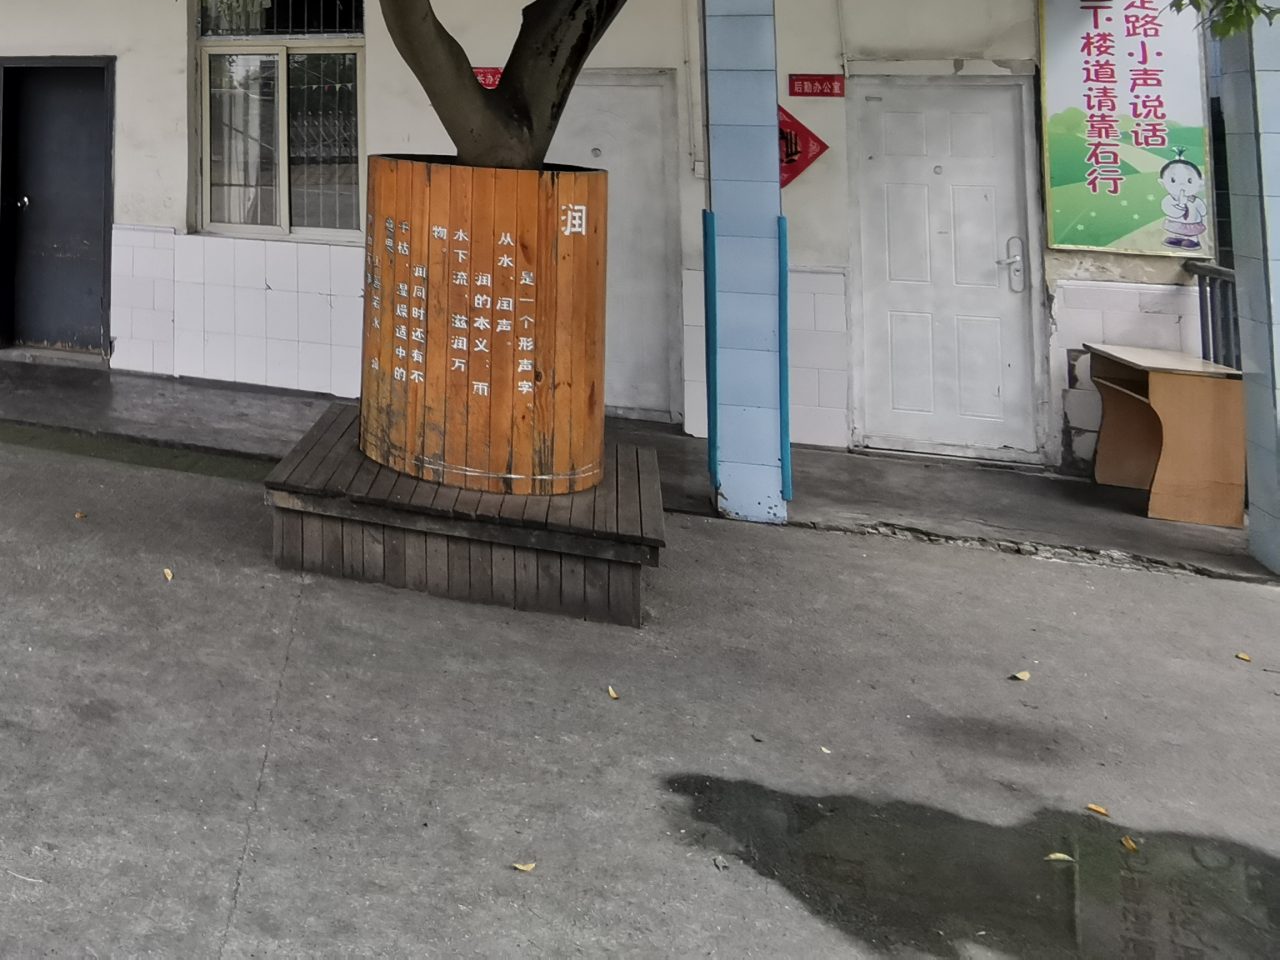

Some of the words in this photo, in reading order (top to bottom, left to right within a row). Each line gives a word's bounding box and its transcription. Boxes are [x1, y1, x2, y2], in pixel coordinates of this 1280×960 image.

[794, 81, 841, 94] 后勤办公室
[561, 203, 587, 237] 润
[409, 264, 427, 383] 润同时还有不
[451, 228, 469, 373] 水下流，滋润万
[472, 271, 491, 397] 润的本义：雨
[517, 270, 535, 408] 是一个形声字。
